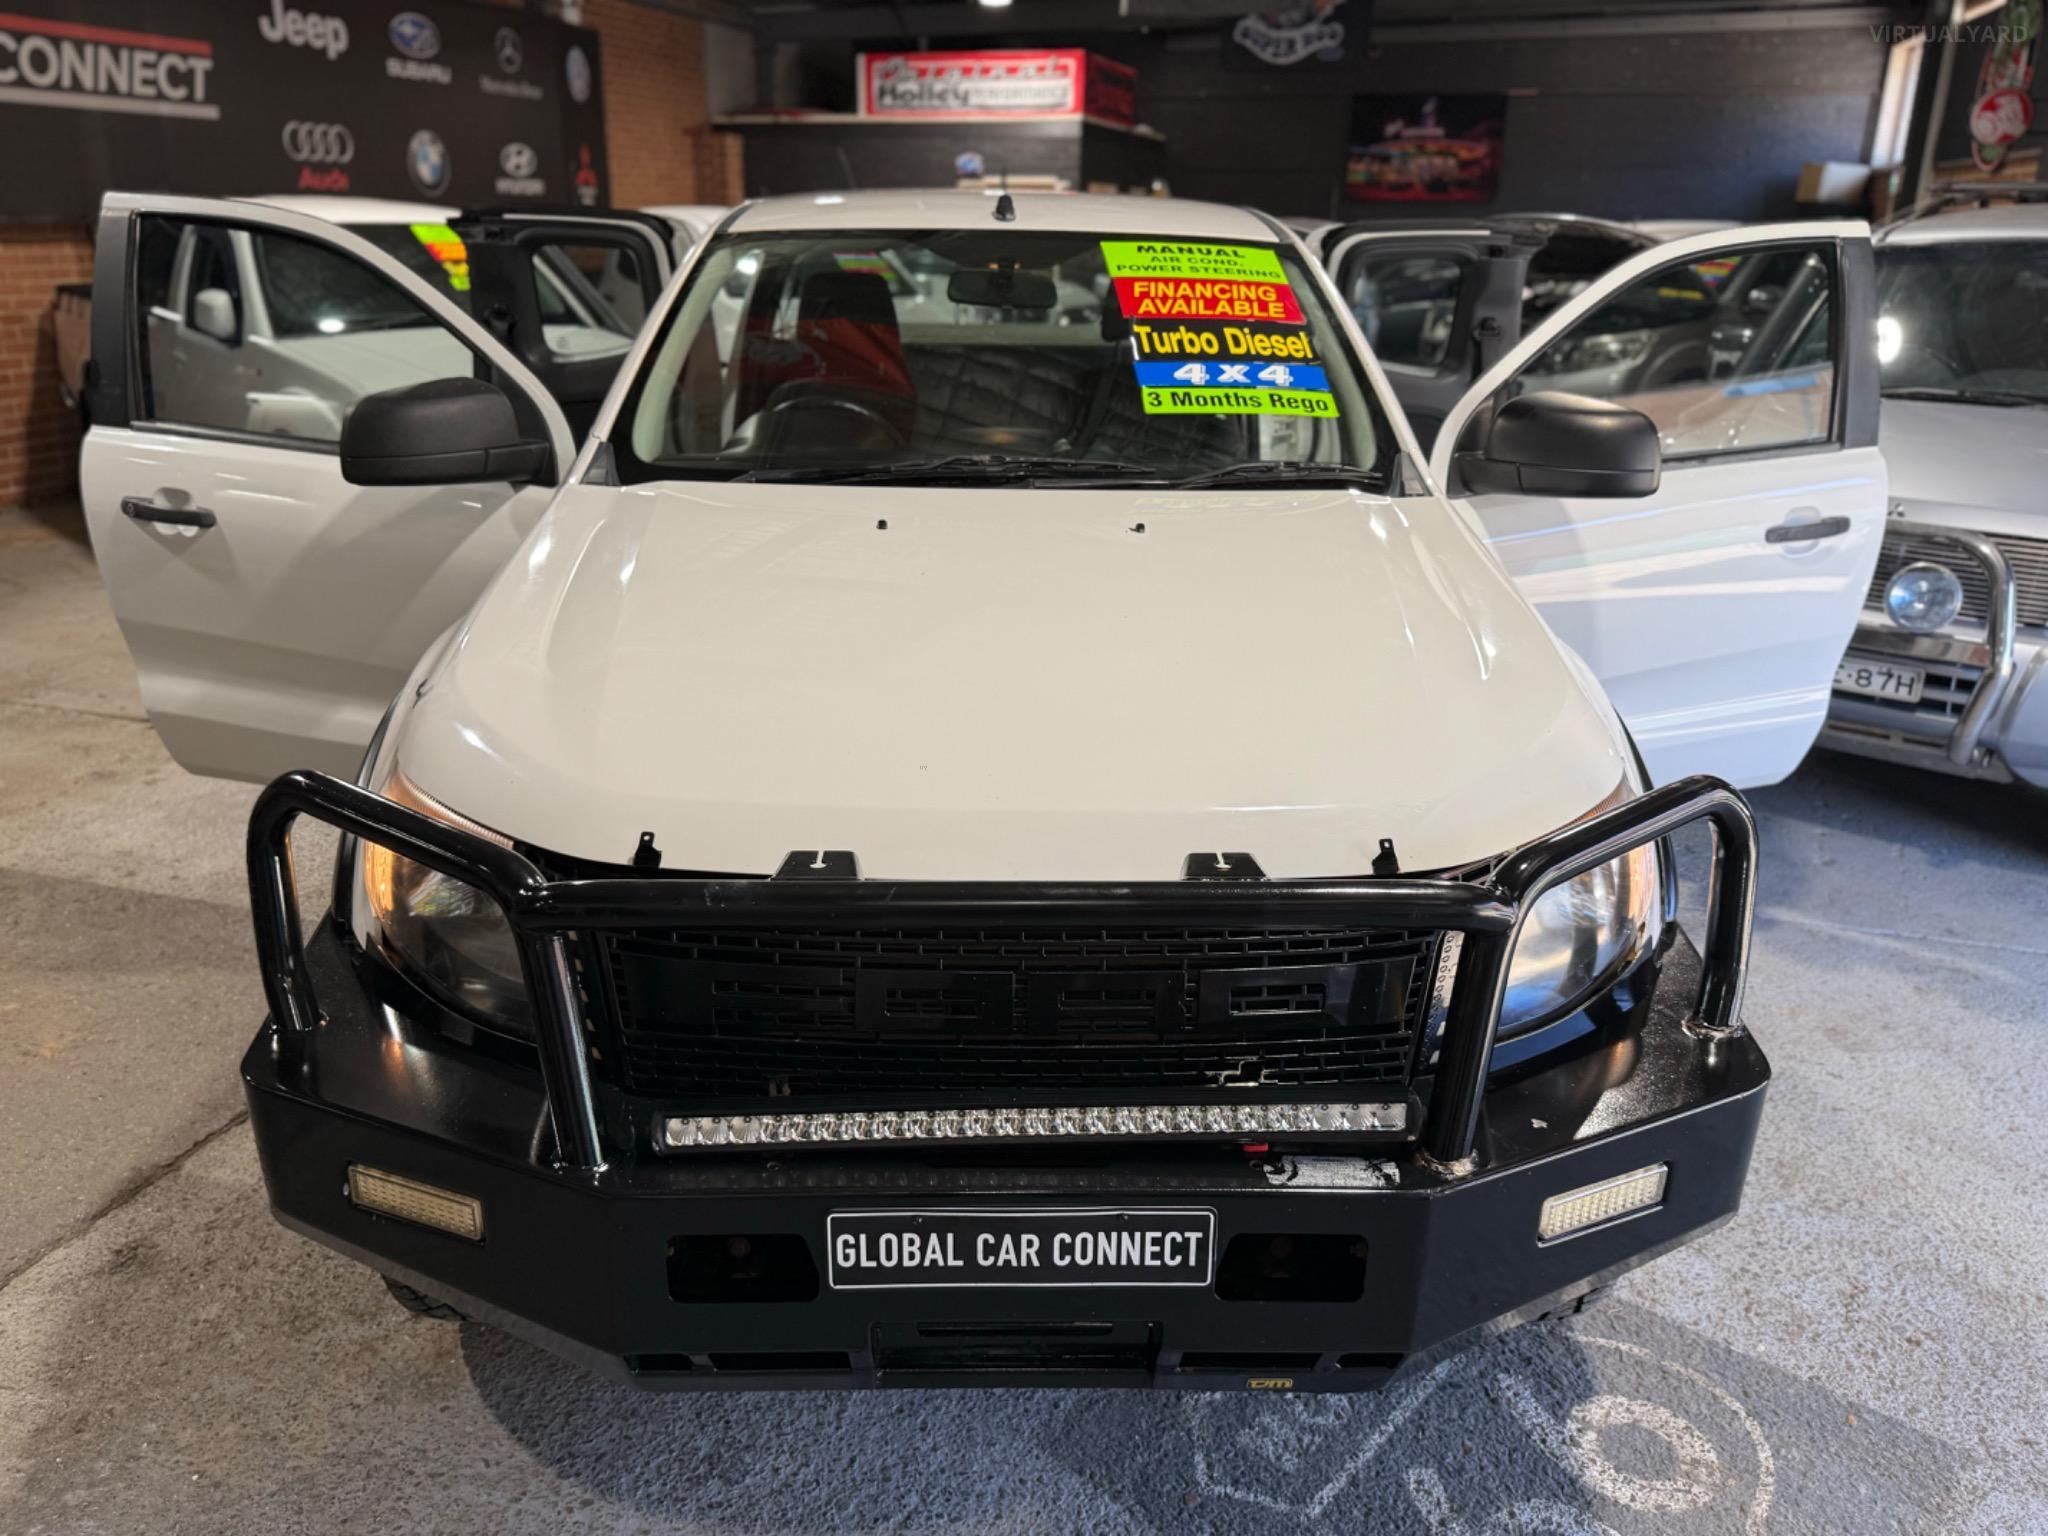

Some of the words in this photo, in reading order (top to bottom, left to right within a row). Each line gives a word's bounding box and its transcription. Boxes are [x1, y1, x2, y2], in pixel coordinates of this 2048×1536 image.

[258, 0, 349, 61] Jeep
[1137, 244, 1246, 259] MANUAL
[1150, 256, 1183, 266] AIR
[1187, 256, 1244, 267] COND.
[1117, 264, 1183, 275] POWER
[1189, 265, 1281, 279] STEERING
[1133, 281, 1277, 301] FINANCING
[1138, 298, 1286, 318] AVAILABLE
[1133, 324, 1219, 355] Turbo
[1223, 326, 1313, 359] Diesel
[1173, 363, 1210, 386] 4
[1257, 364, 1294, 387] 4
[1147, 392, 1162, 408] 3
[1171, 391, 1263, 409] Months
[1269, 393, 1329, 414] Rego
[836, 1233, 964, 1268] GLOBAL
[975, 1232, 1041, 1267] CAR
[1052, 1231, 1204, 1268] CONNECT
